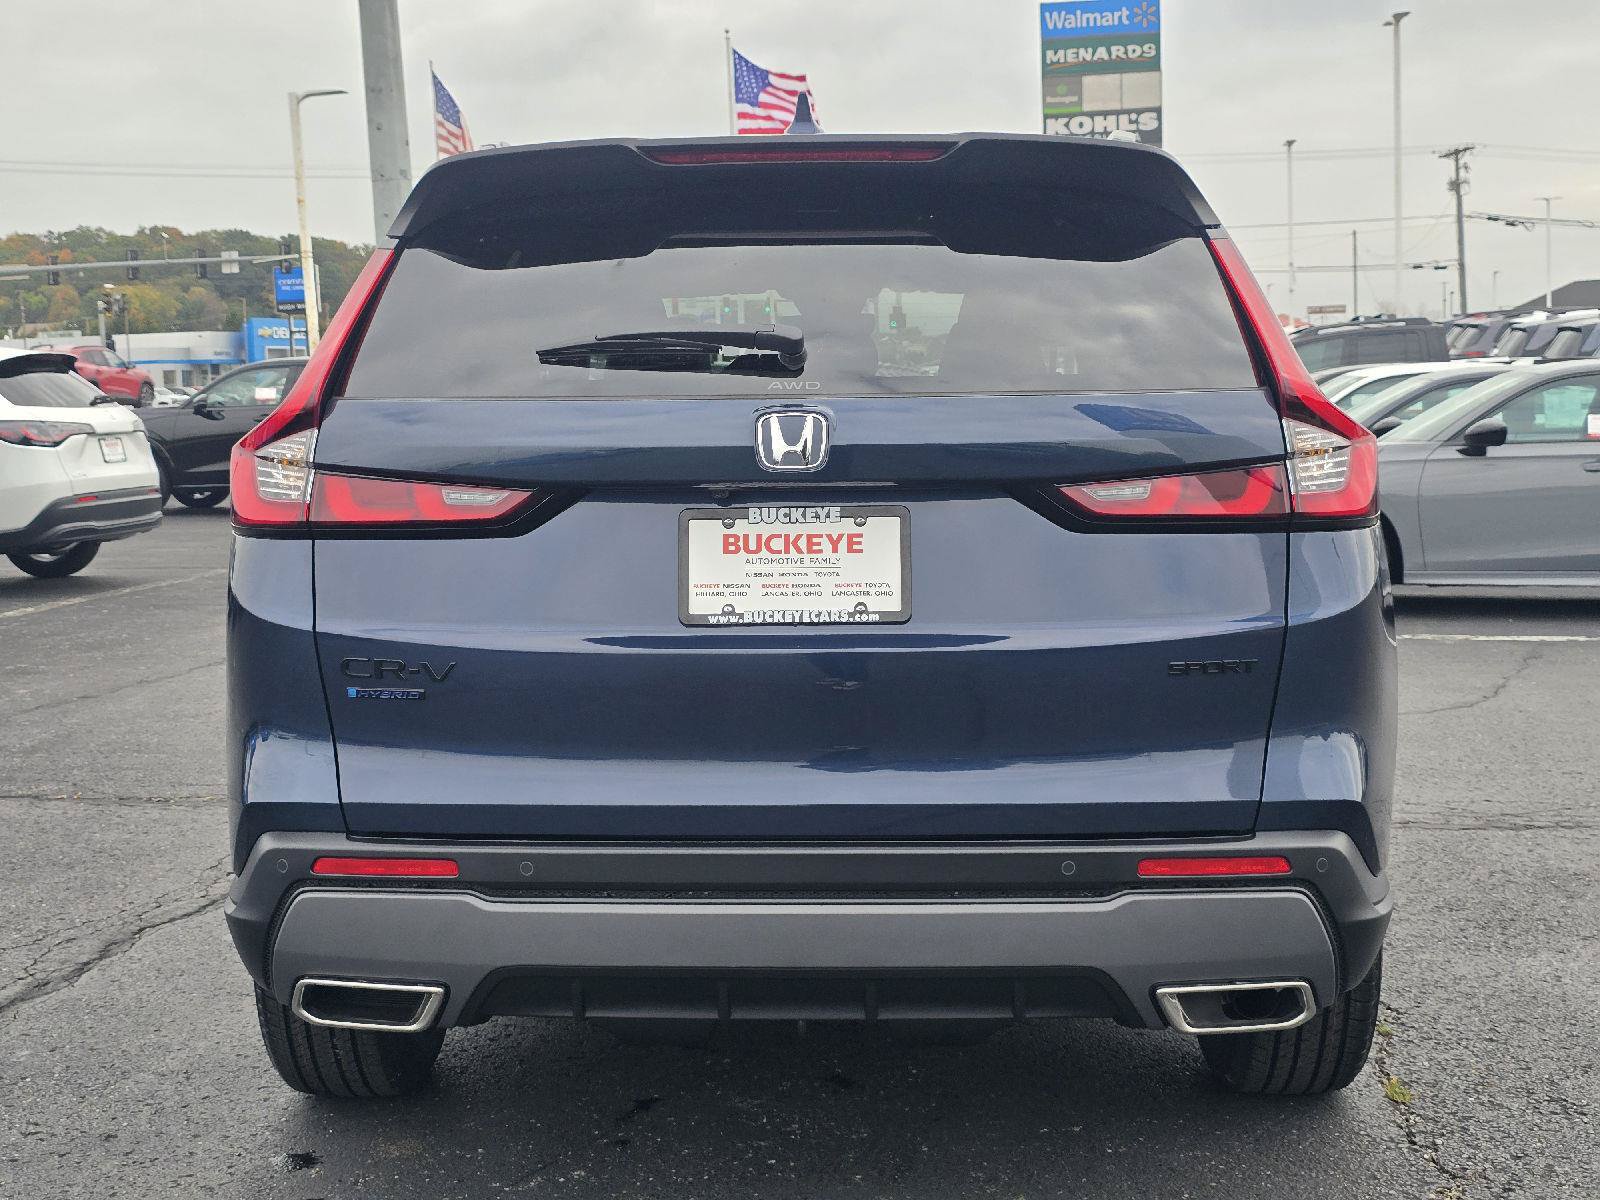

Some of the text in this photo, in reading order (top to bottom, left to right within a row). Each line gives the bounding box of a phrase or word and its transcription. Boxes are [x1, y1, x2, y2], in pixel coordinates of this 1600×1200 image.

[1044, 6, 1131, 30] Walmart
[1045, 43, 1157, 64] MENARDS
[1045, 111, 1160, 135] KOHL'S
[767, 381, 821, 390] AWD
[748, 507, 842, 524] BUCKEYE
[722, 533, 864, 555] BUCKEYE
[745, 557, 841, 565] AUTOMOTIVE FAMILY
[708, 609, 880, 624] www.BUCKEYECARS.com
[341, 657, 457, 681] CR-V
[1168, 659, 1259, 675] SPORT
[357, 690, 421, 699] HYBRID
